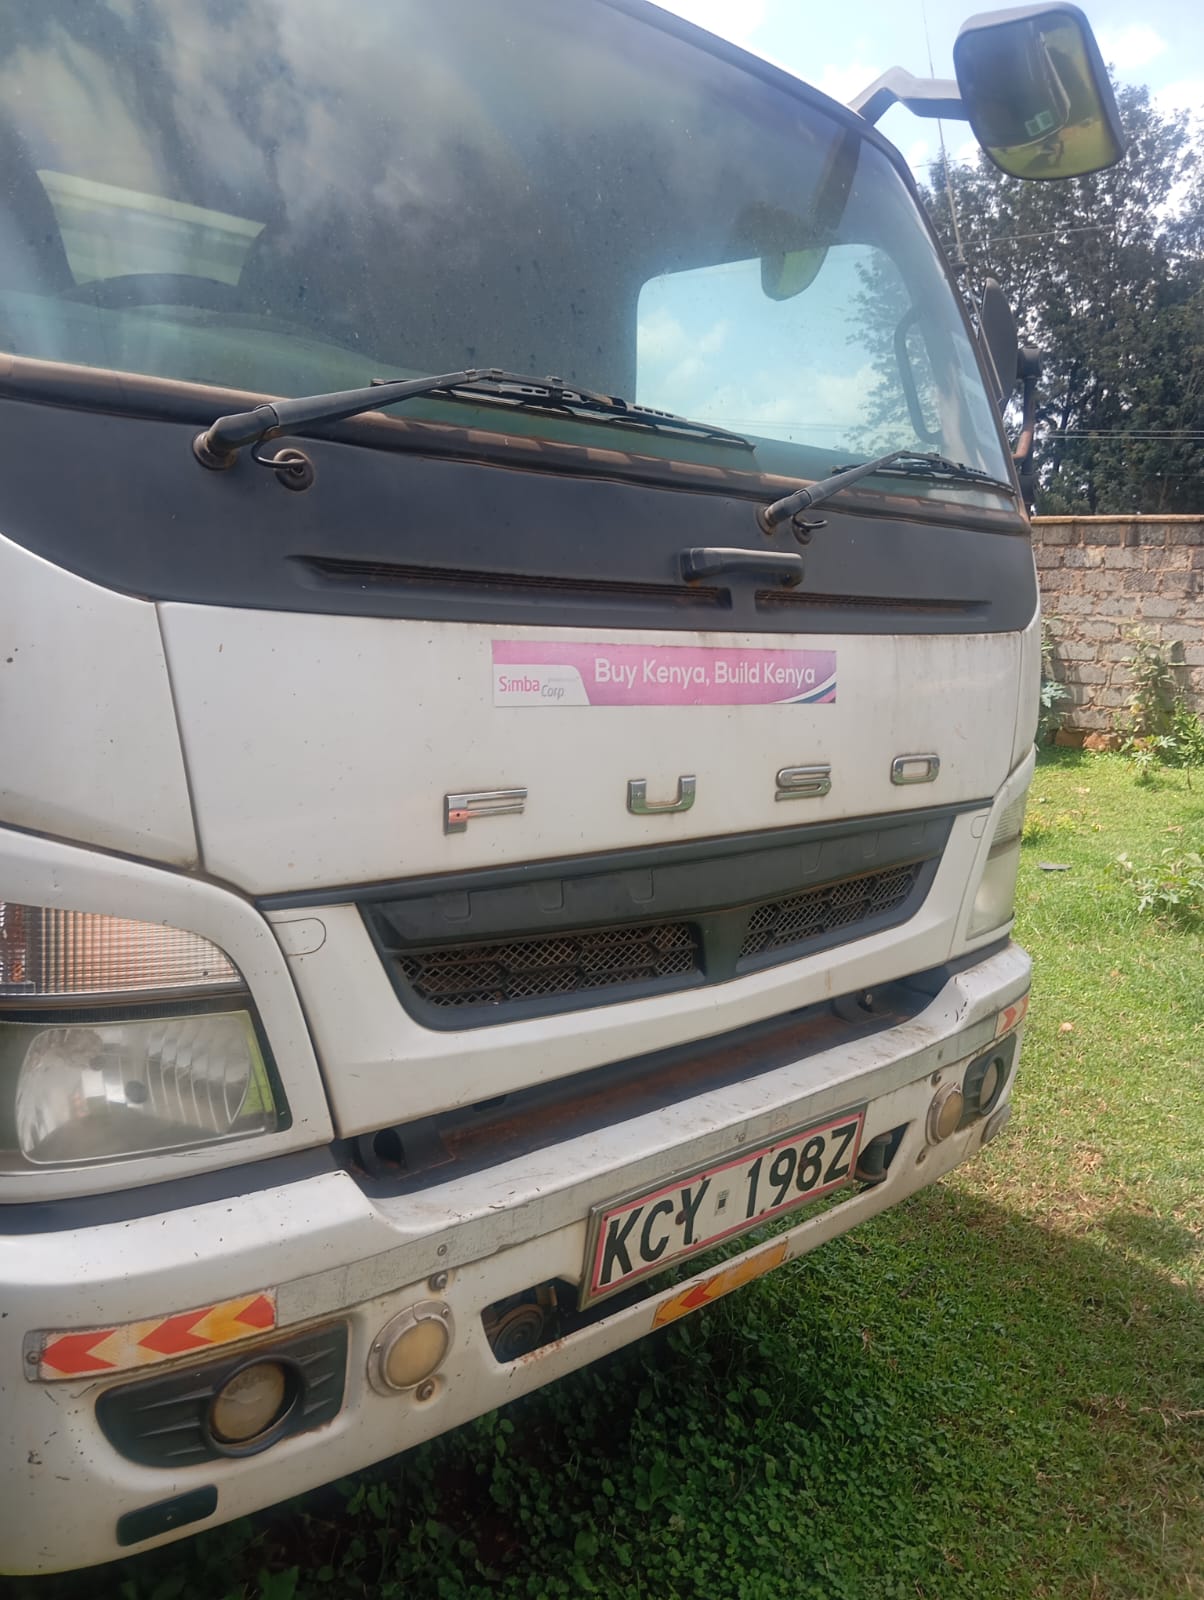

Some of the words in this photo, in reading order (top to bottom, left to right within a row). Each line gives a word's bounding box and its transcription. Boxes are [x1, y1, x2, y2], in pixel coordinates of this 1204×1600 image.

[499, 676, 540, 693] Simba
[541, 684, 564, 699] Corp
[595, 658, 637, 689] Buy
[643, 660, 710, 686] Kenya,
[715, 662, 760, 684] Build
[764, 662, 815, 688] Kenya
[444, 753, 940, 834] FUSO
[600, 1179, 711, 1286] KCY
[745, 1121, 858, 1219] 198Z
